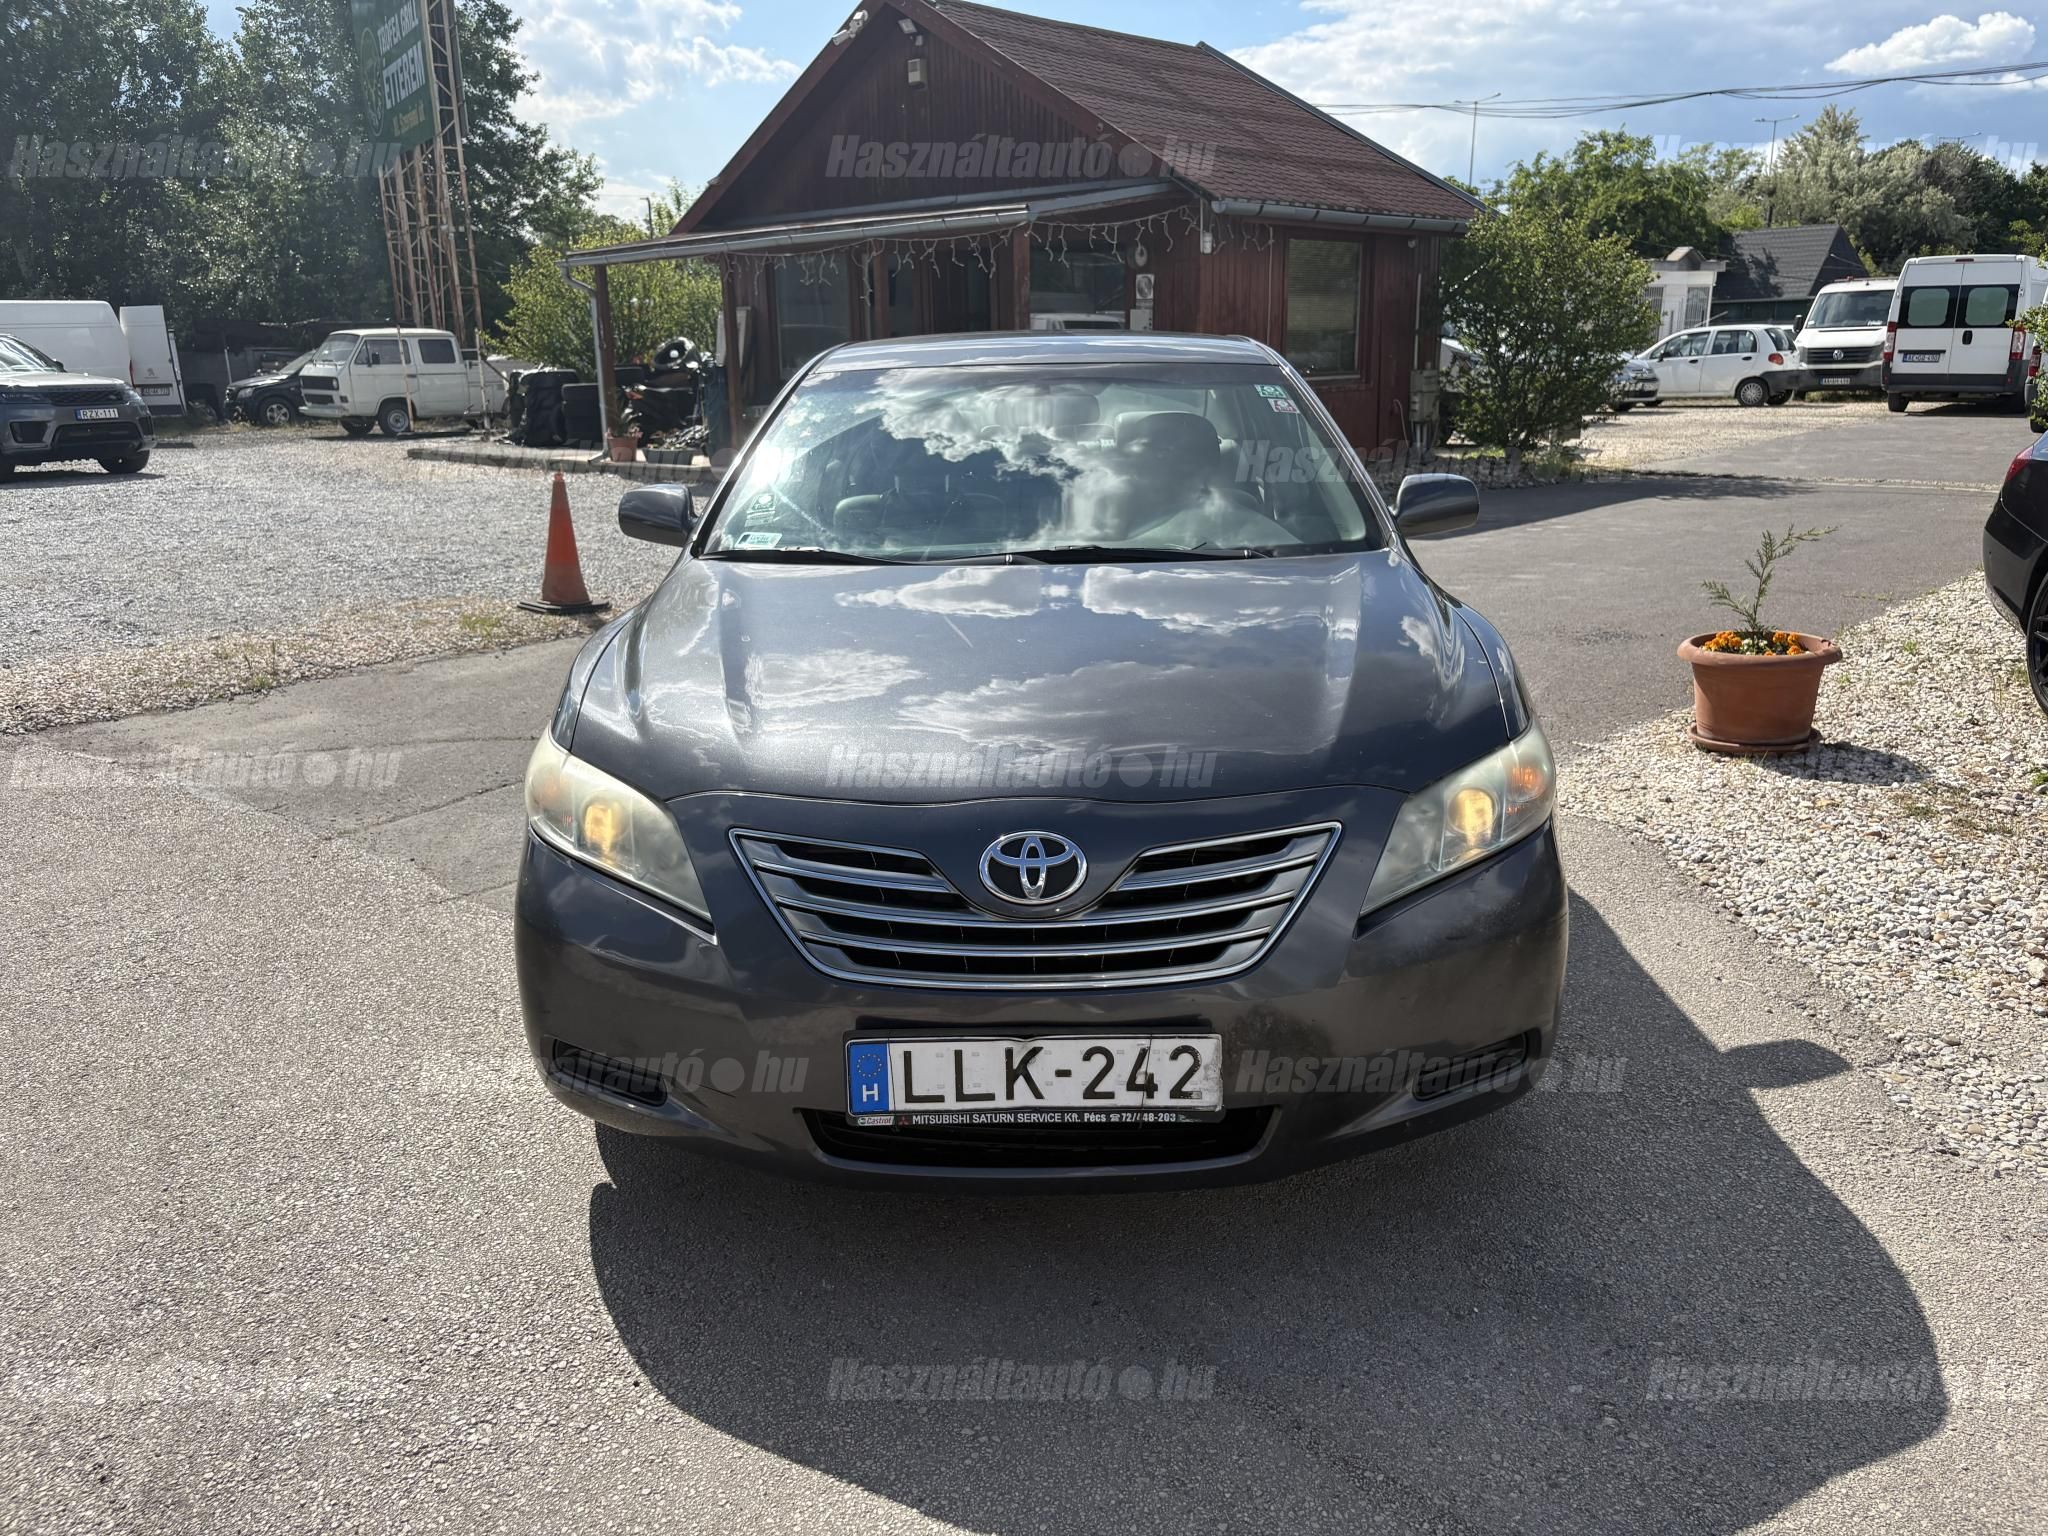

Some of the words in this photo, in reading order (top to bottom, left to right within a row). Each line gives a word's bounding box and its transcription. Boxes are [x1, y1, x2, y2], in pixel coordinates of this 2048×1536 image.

[82, 408, 118, 419] RZX-111
[903, 1045, 1204, 1103] LLK-242
[862, 1083, 879, 1102] H
[866, 1116, 892, 1125] Castrol
[912, 1114, 970, 1125] MITSUBISHI
[972, 1113, 1014, 1124] SATURN
[1017, 1112, 1061, 1123] SERVICE
[1064, 1112, 1081, 1123] Kft.
[1083, 1111, 1107, 1122] Pécs
